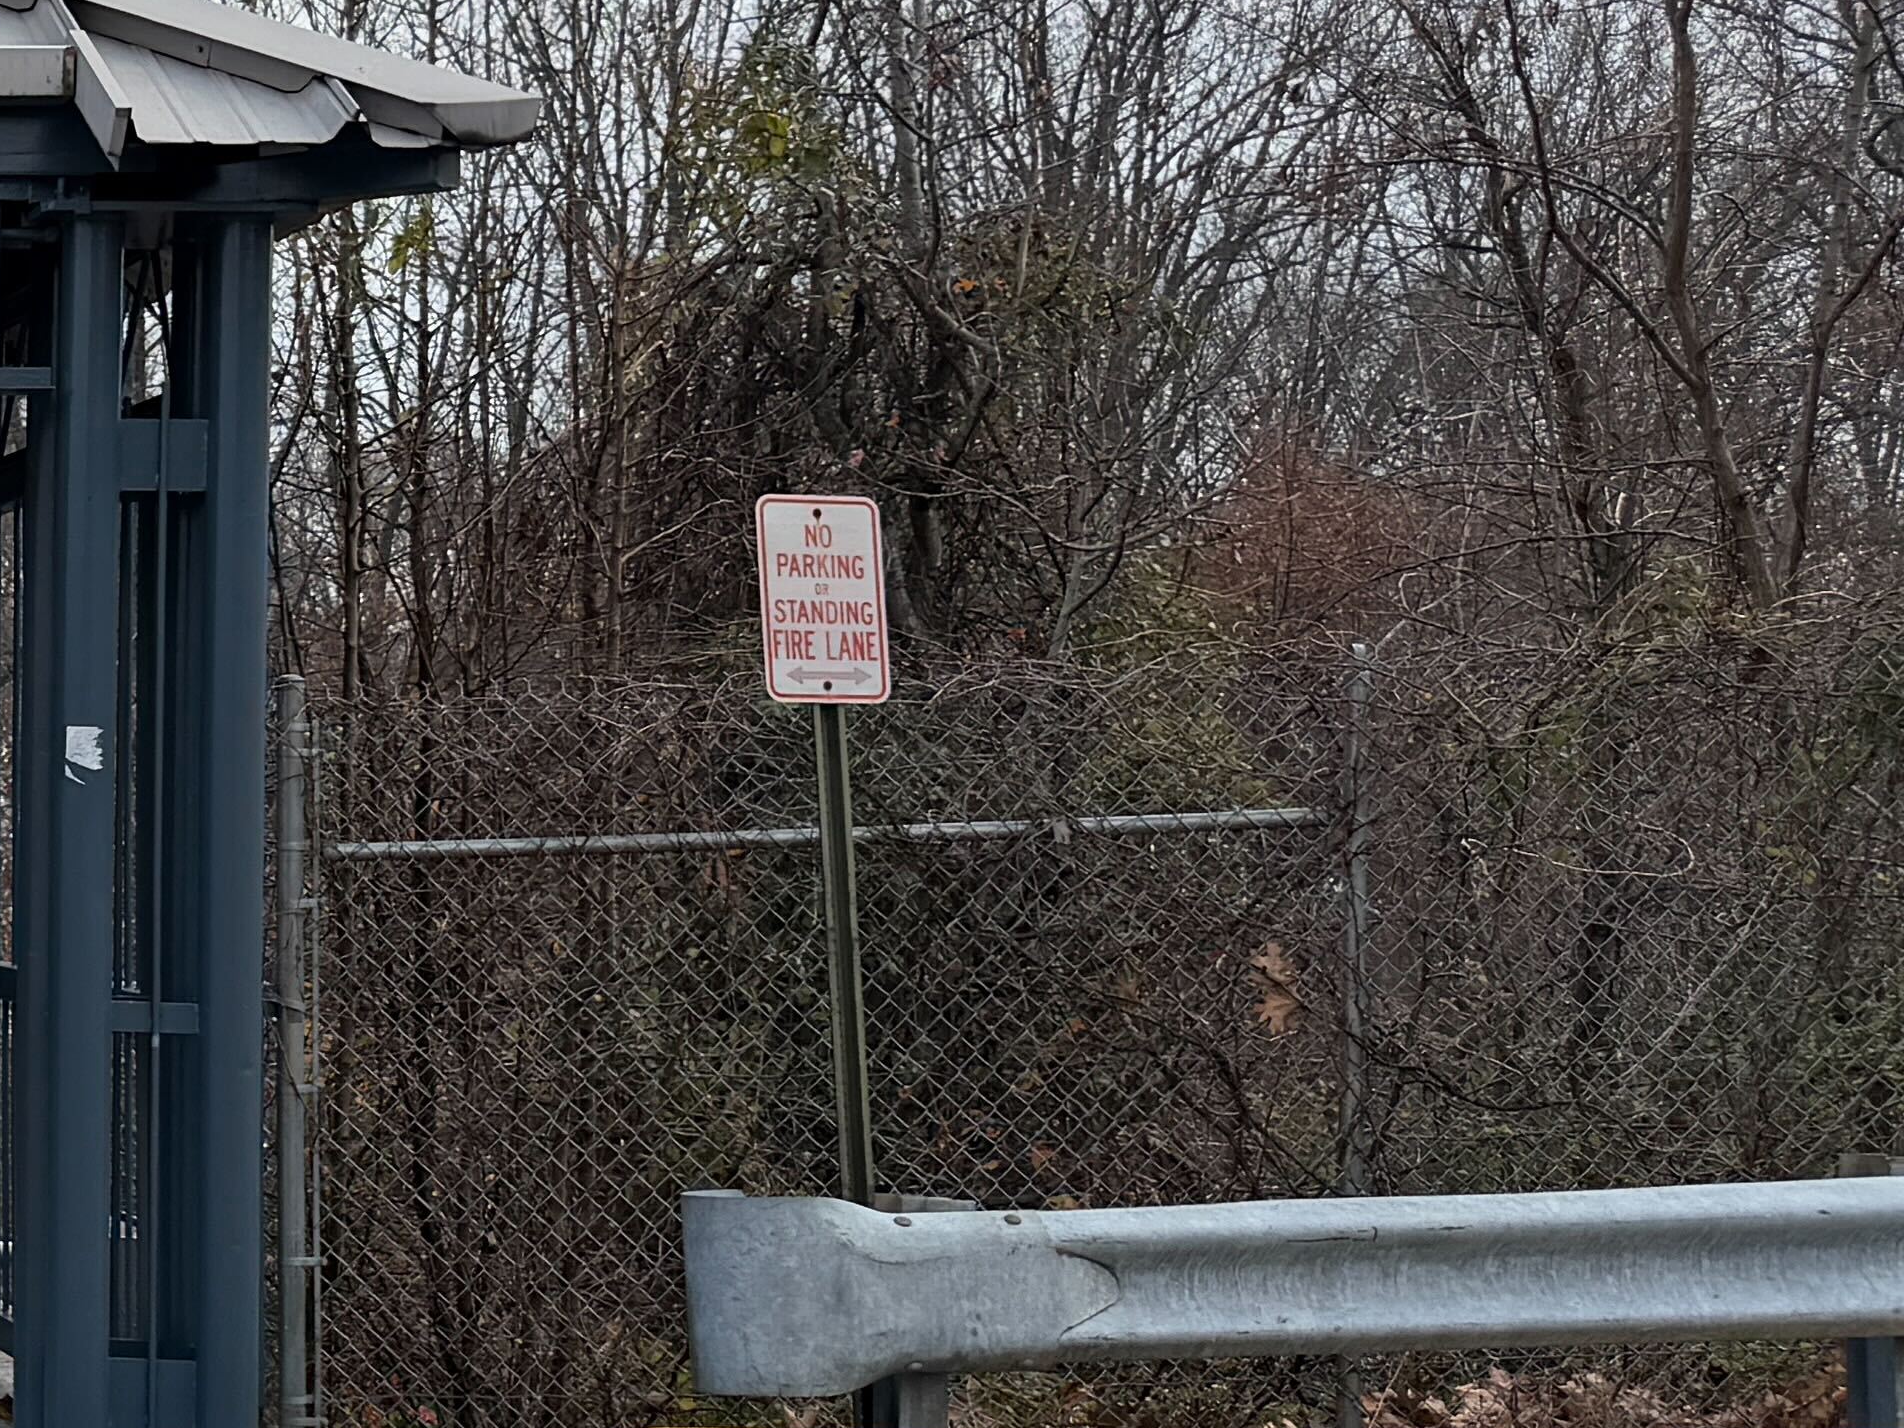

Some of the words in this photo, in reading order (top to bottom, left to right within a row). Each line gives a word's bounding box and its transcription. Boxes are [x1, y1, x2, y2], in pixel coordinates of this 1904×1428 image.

[804, 523, 832, 548] NO
[776, 553, 865, 580] PARKING
[814, 582, 830, 596] OR
[774, 598, 874, 626] STANDING
[772, 628, 816, 660] FIRE
[825, 630, 879, 662] LANE
